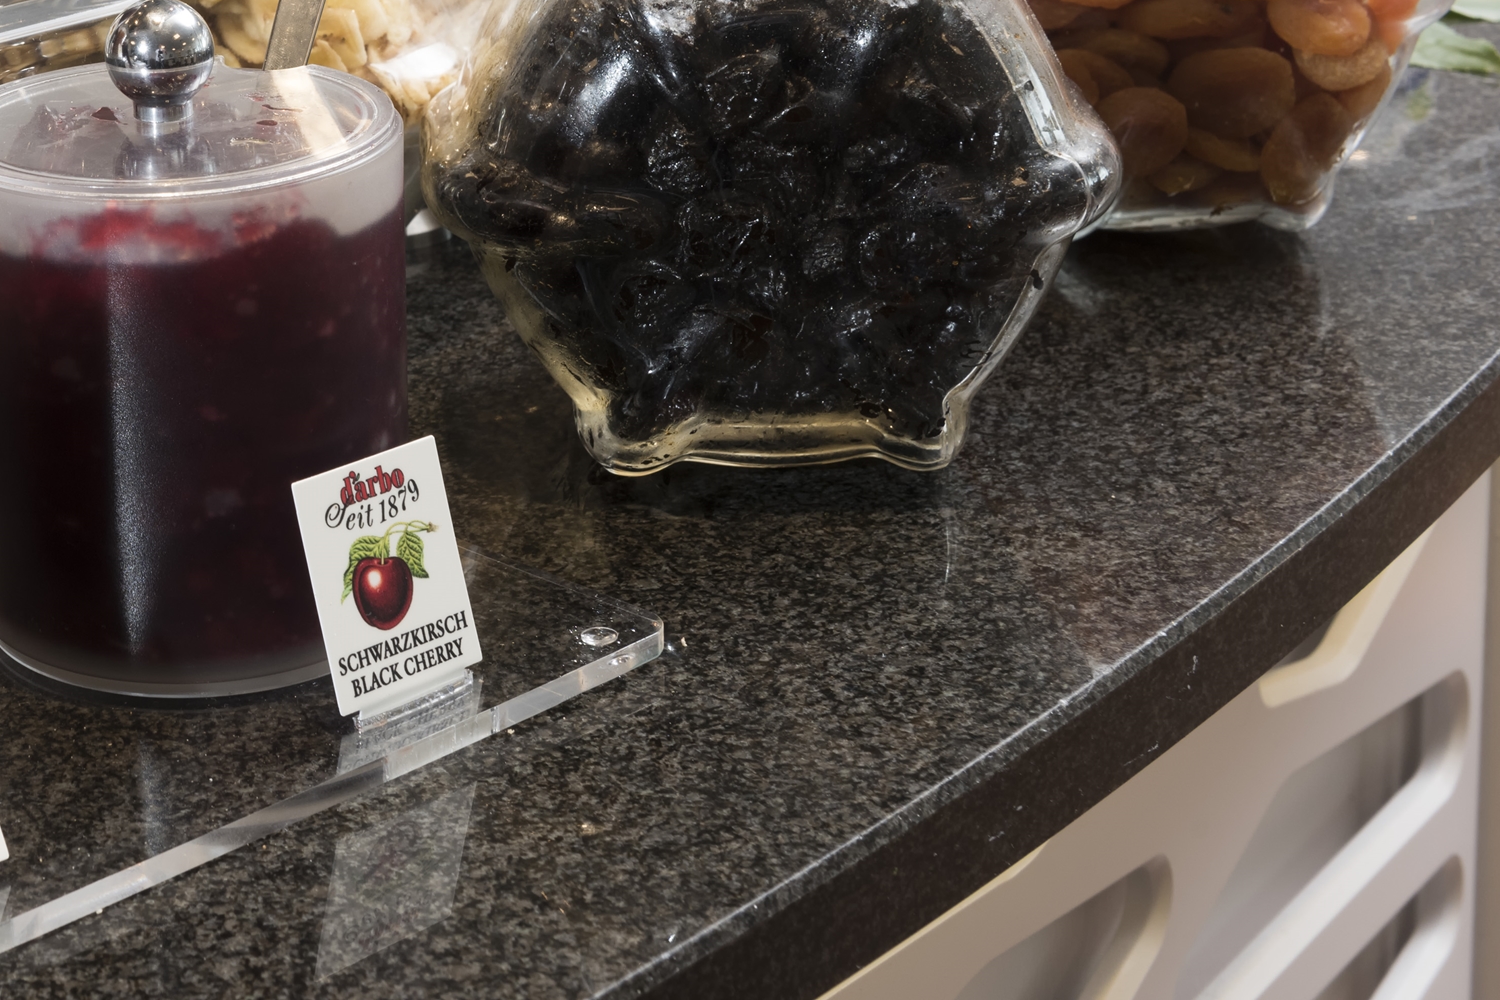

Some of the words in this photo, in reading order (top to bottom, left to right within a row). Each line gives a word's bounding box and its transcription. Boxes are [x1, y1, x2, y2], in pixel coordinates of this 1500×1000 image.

[324, 499, 374, 530] Seit
[379, 478, 420, 524] 1879
[338, 610, 468, 676] SCHWARZKIRSCH
[351, 663, 403, 698] BLACK
[403, 637, 464, 675] CHERRY
